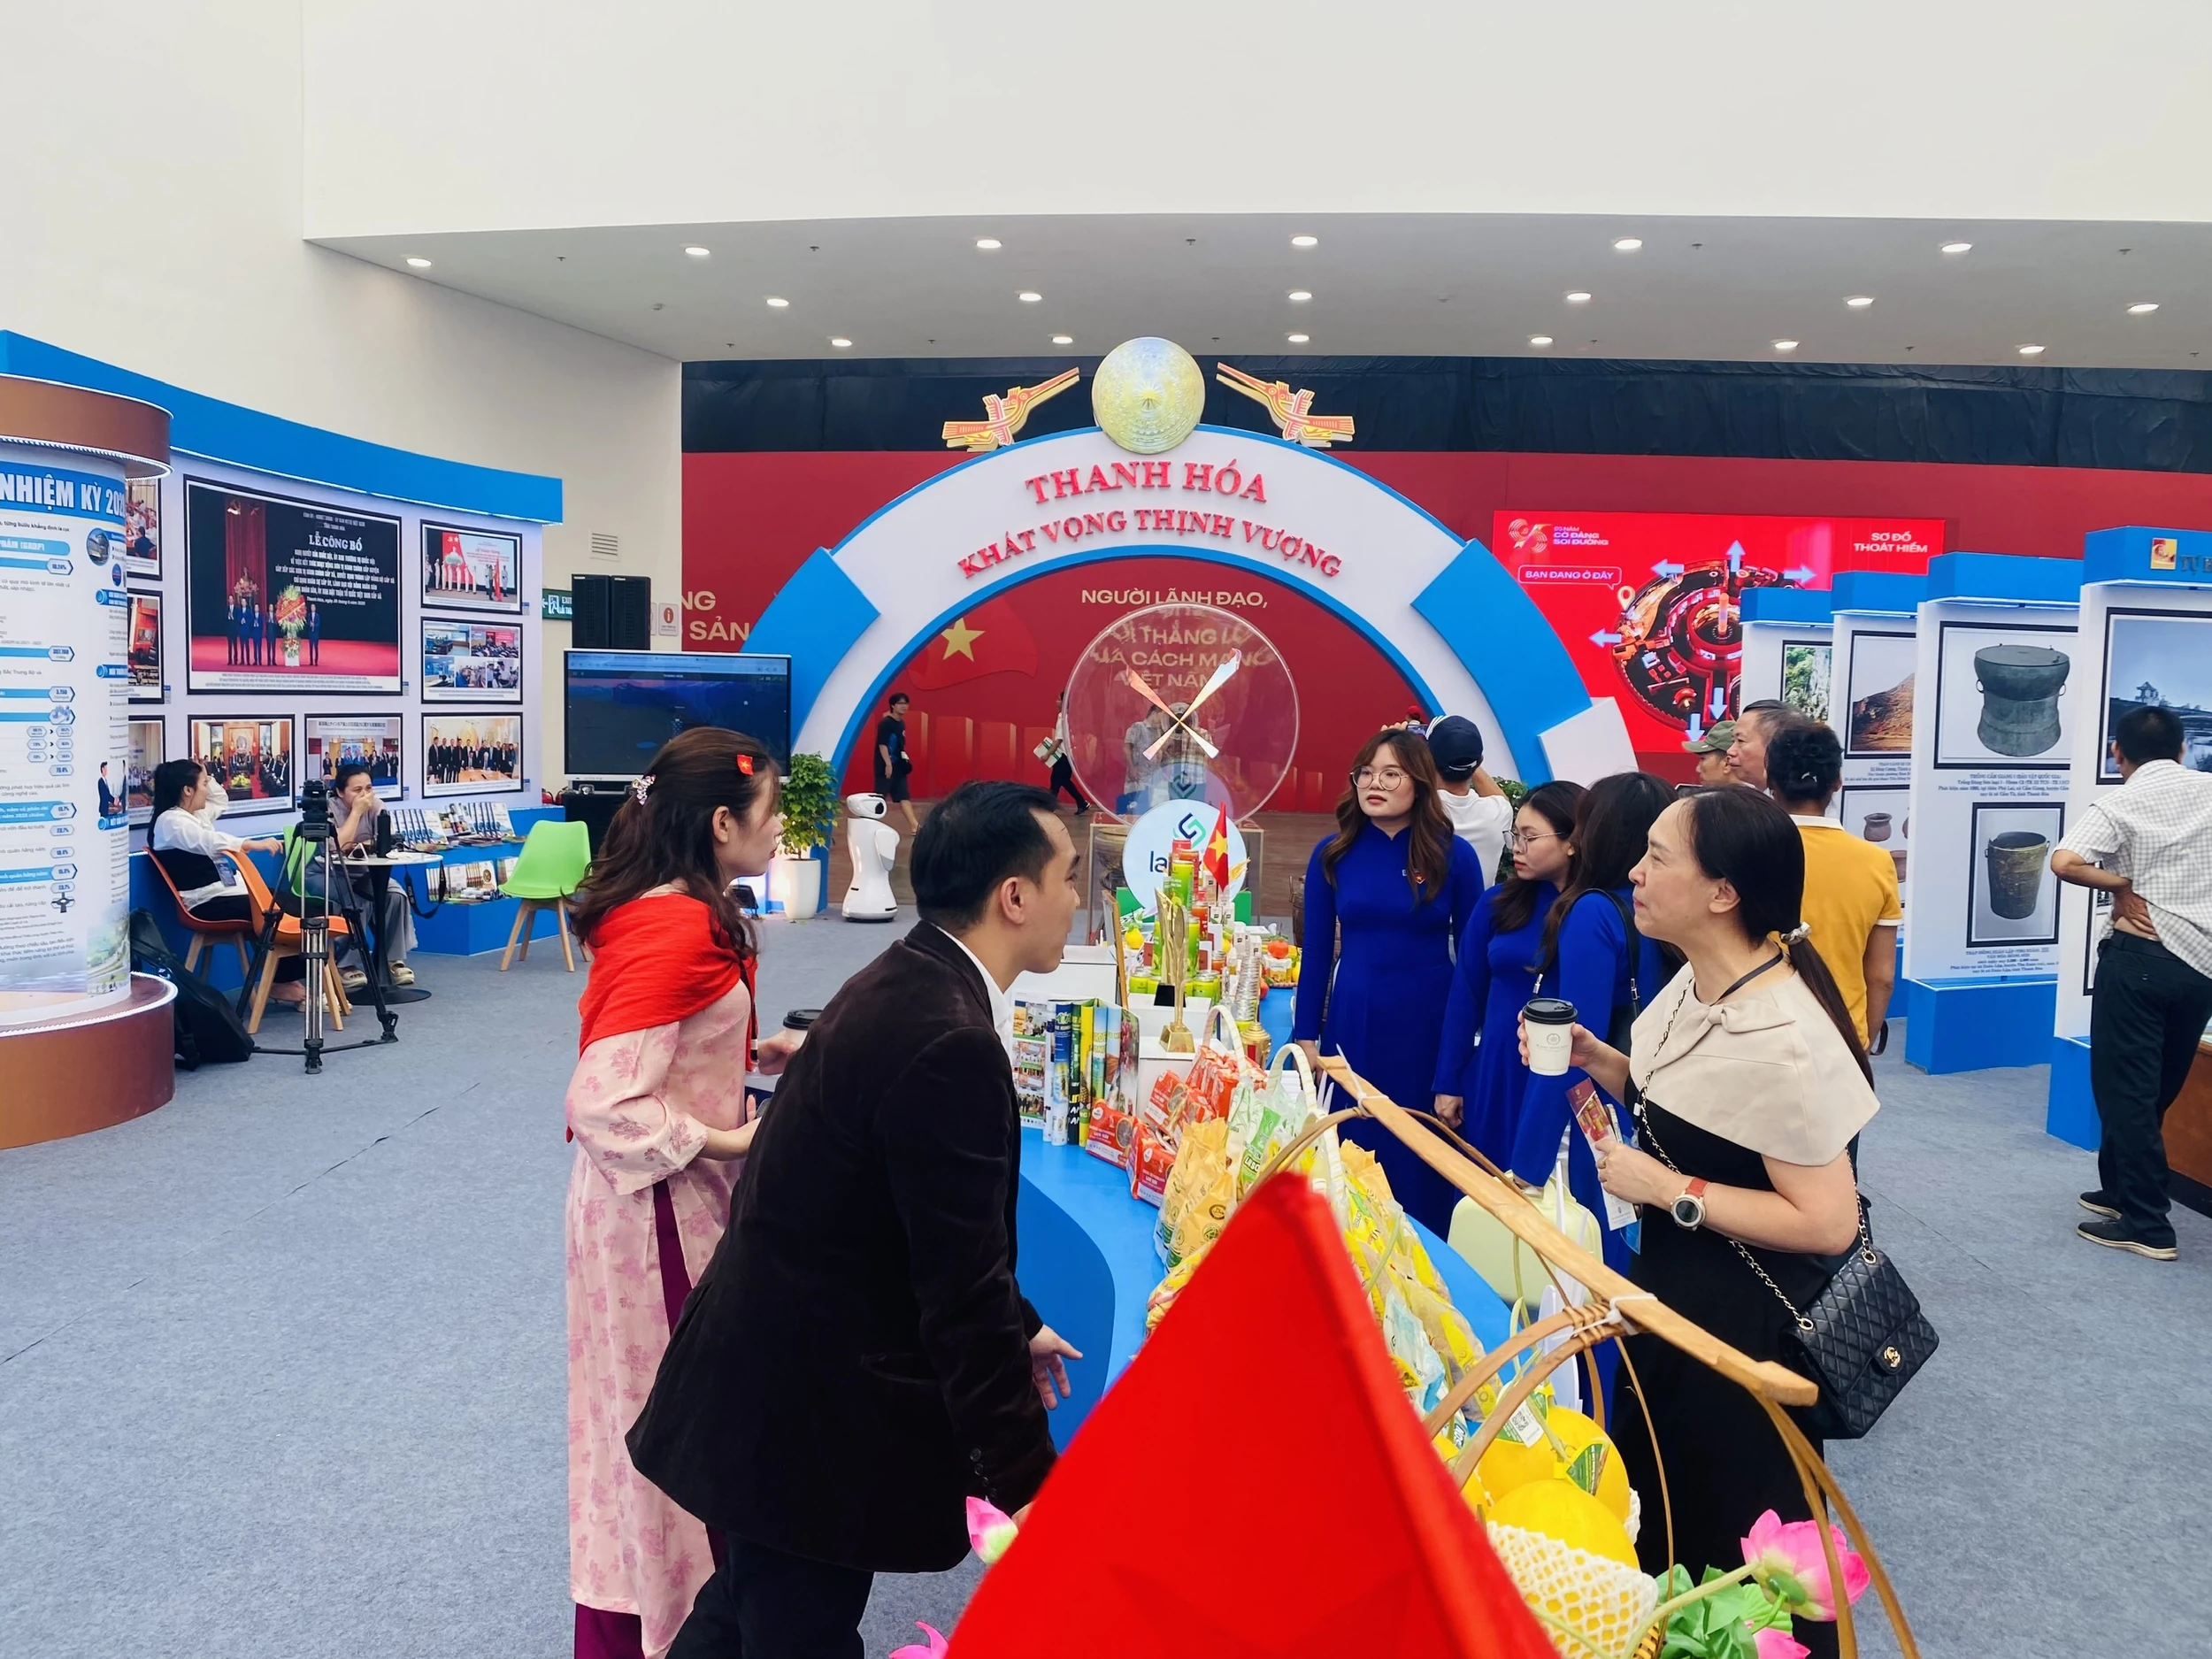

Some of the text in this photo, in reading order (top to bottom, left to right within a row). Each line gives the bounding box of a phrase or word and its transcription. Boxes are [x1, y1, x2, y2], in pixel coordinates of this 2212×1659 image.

[1025, 458, 1266, 503] THANH HÓA
[0, 473, 74, 511] NHIỆM
[81, 481, 102, 512] KỲ
[309, 531, 363, 551] LỄ CÔNG BỐ
[956, 509, 1342, 579] KHÁT VỌNG THỊNH VƯỢNG
[1871, 531, 1912, 542] SƠ ĐỒ
[1854, 541, 1928, 553] THOÁT HIỂM
[1525, 571, 1548, 580] BẠN
[1549, 571, 1580, 580] ĐANG
[1593, 571, 1614, 580] ĐÂY
[1081, 588, 1268, 609] NGƯỜI LÃNH ĐẠO,
[689, 616, 749, 641] SẢN
[1132, 649, 1194, 665] CÁCH
